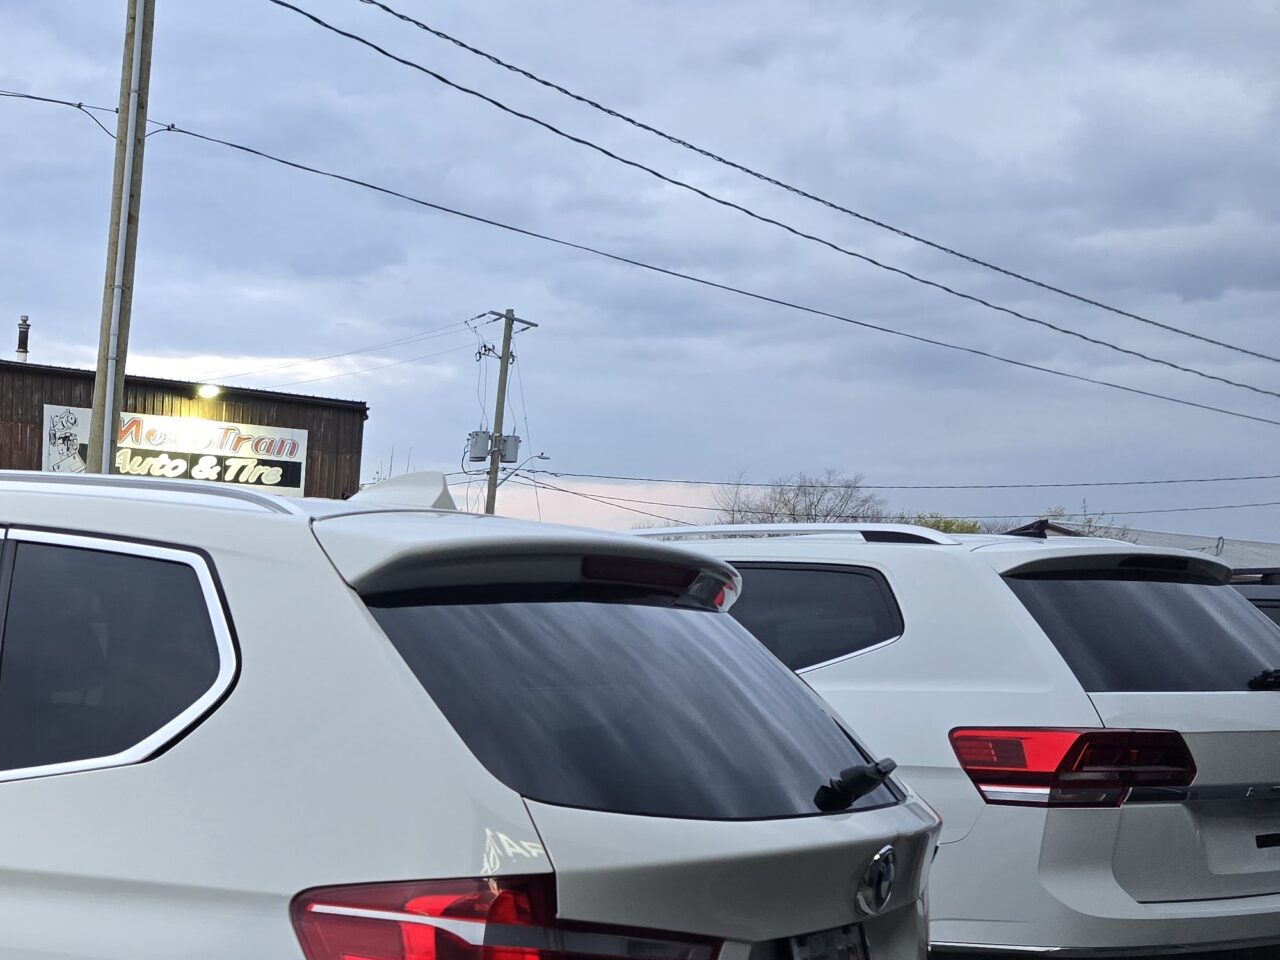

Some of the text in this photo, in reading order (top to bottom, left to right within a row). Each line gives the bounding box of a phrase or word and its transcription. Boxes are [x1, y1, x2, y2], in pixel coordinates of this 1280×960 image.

[115, 448, 283, 485] Auto & Tire
